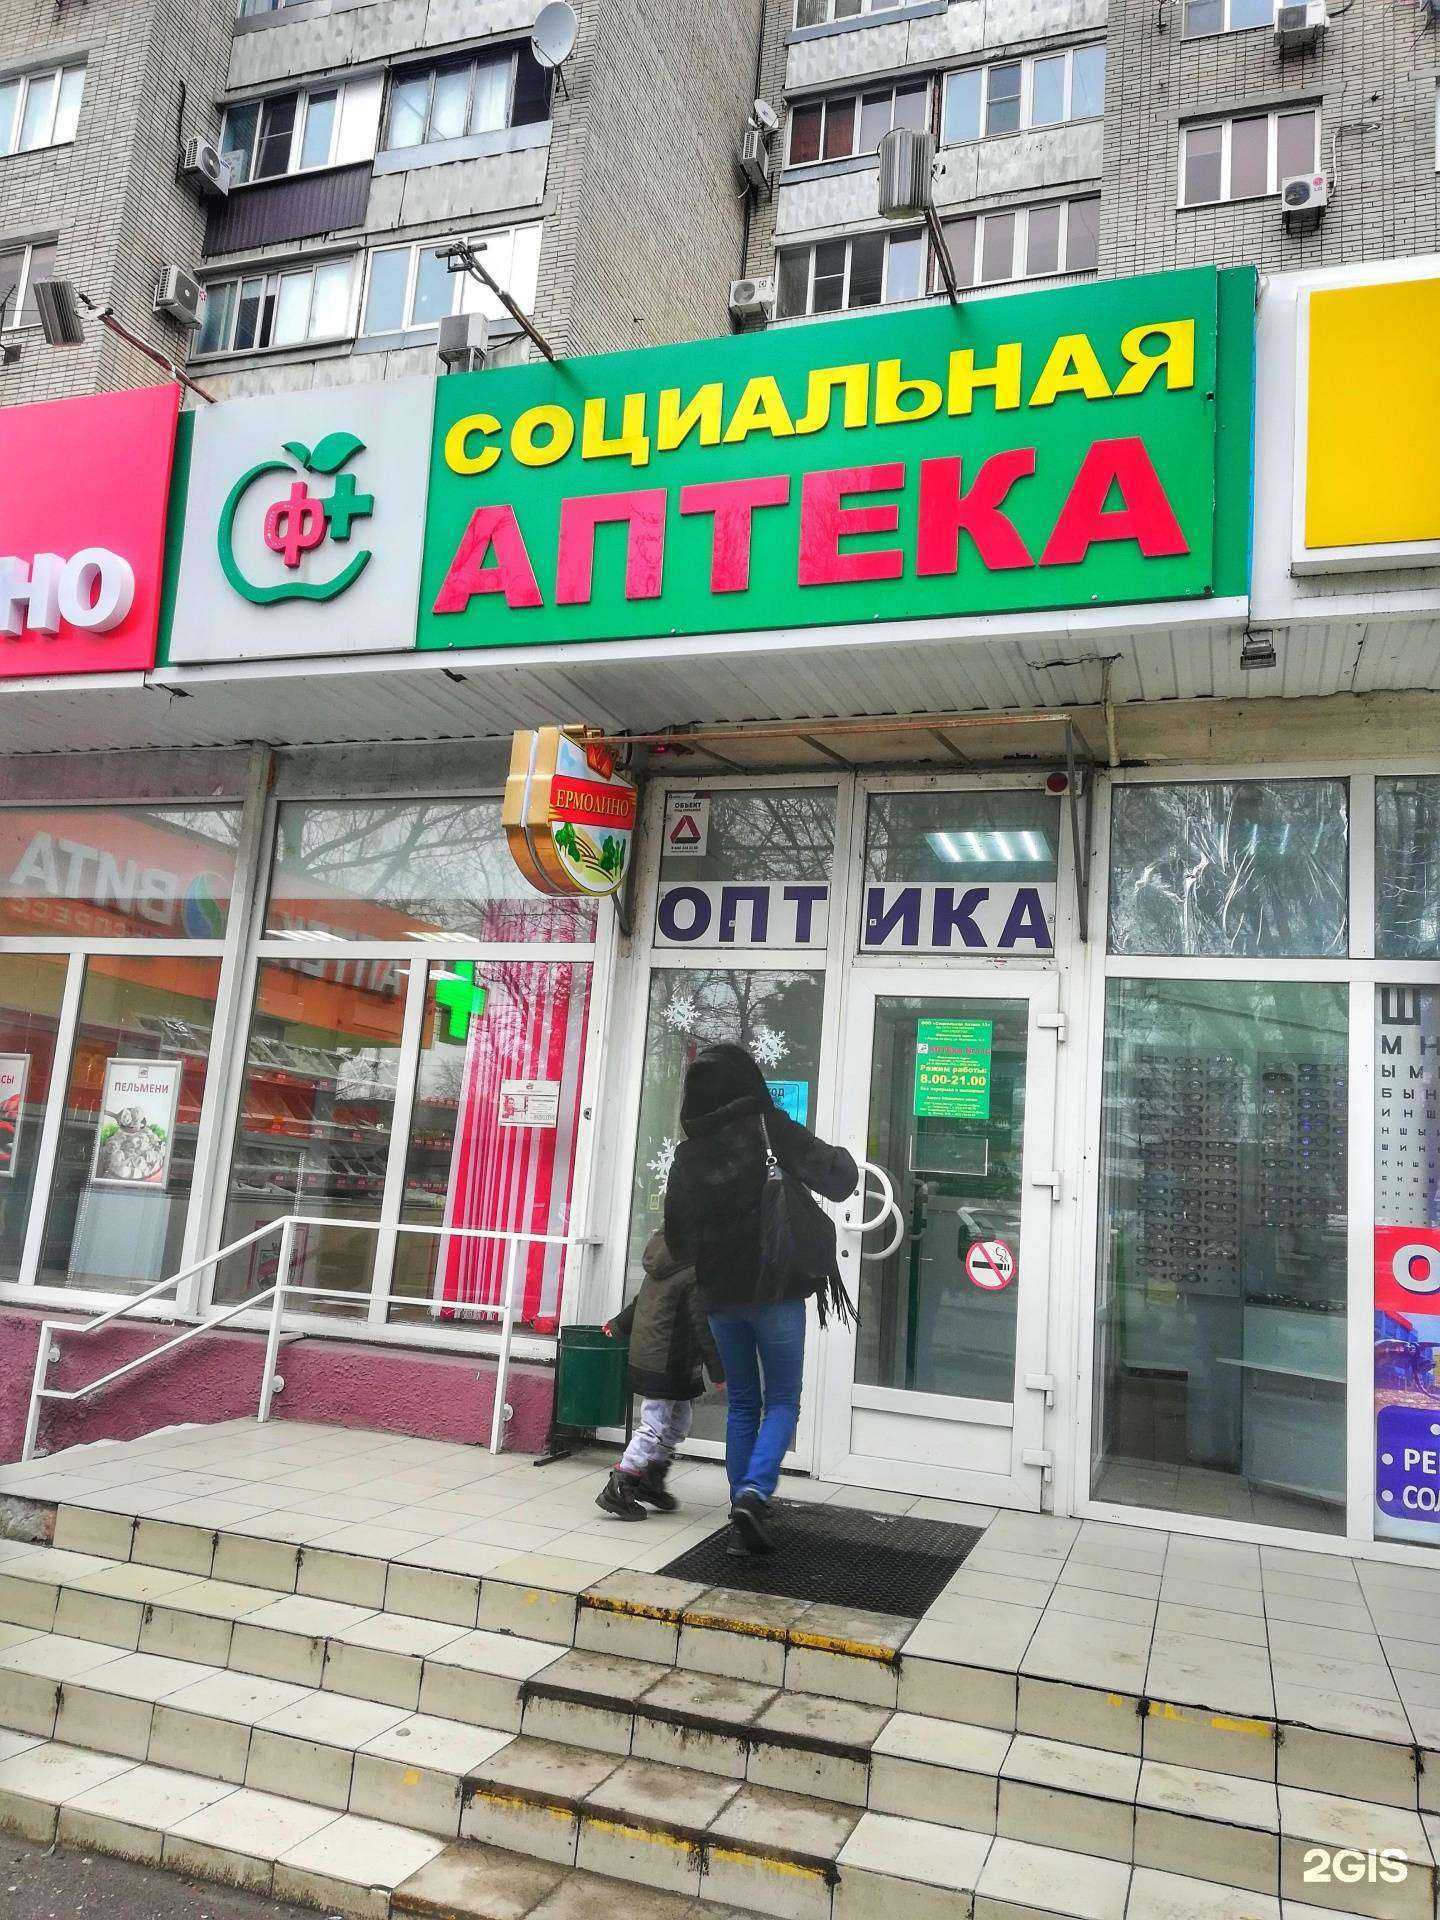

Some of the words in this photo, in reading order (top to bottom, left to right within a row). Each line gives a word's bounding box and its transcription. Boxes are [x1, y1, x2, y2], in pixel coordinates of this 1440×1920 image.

[444, 319, 1195, 475] СОЦИАЛЬНАЯ
[432, 436, 1190, 615] АПТЕКА
[556, 789, 629, 817] ЕРМОЛИНО
[658, 886, 1053, 949] ОПТИКА
[1381, 988, 1421, 1025] Ш
[1381, 1035, 1401, 1054] М
[920, 1064, 951, 1073] Режим
[1381, 1065, 1395, 1078] Ы
[1409, 1065, 1424, 1079] М
[114, 1081, 169, 1094] ПЕЛЬМЕНИ
[920, 1074, 987, 1086] 8.00-21.00
[1381, 1088, 1392, 1098] Б
[1403, 1089, 1414, 1099] Ы
[1425, 1090, 1436, 1100] Н
[1381, 1108, 1391, 1117] И
[1404, 1109, 1413, 1118] Н
[1427, 1110, 1435, 1119] Ш
